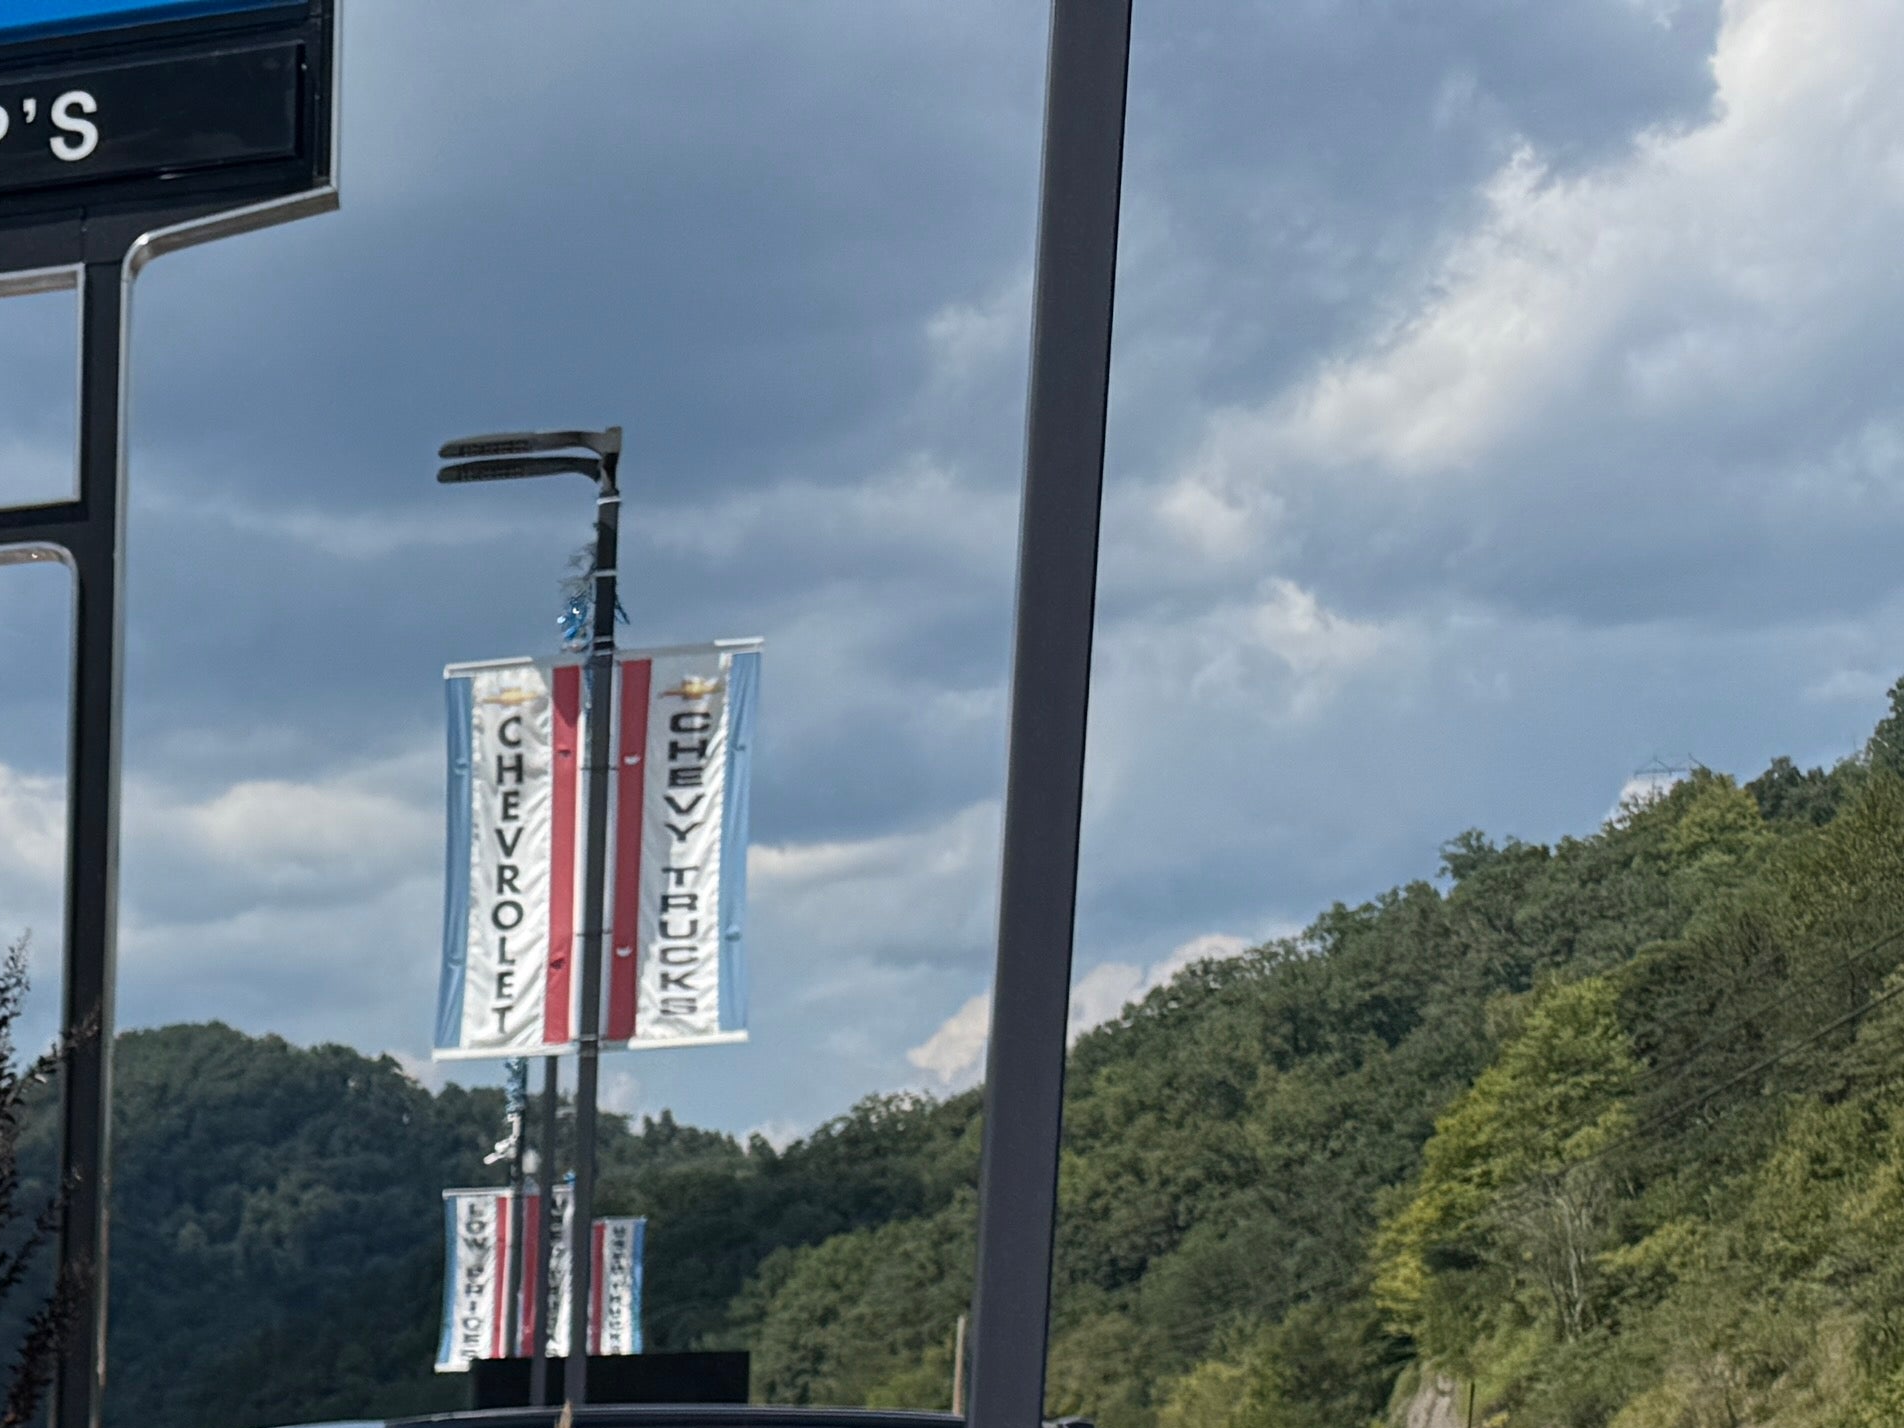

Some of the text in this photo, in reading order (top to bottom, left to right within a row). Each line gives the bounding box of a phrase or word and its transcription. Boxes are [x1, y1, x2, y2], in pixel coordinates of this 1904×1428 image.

[490, 715, 525, 1035] CHEVROLET
[659, 711, 712, 1016] CHEVY TRUCKS
[463, 1203, 488, 1249] LOW
